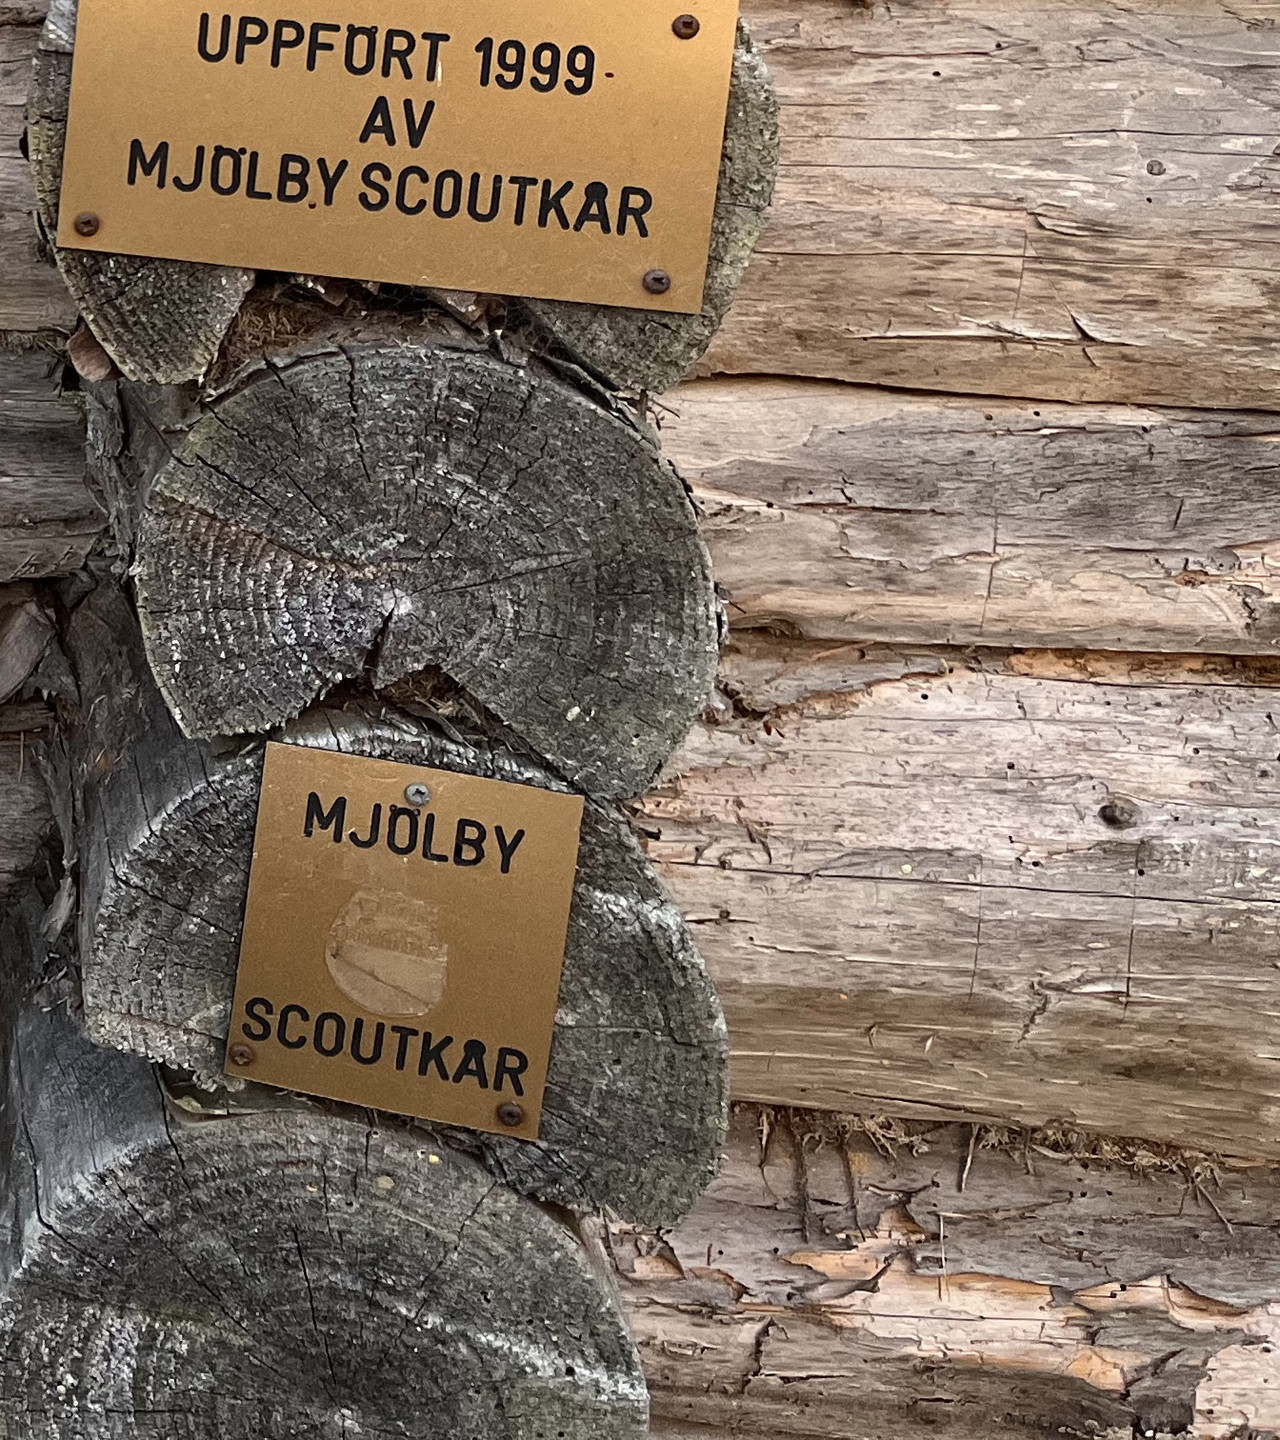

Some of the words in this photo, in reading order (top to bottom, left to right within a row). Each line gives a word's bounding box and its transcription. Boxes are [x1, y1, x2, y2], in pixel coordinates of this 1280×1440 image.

[198, 12, 451, 83] UPPFÖRT
[474, 37, 597, 95] 1999
[359, 96, 436, 148] AV
[127, 139, 348, 206] MJÖLBY
[304, 792, 526, 874] MJÖLBY
